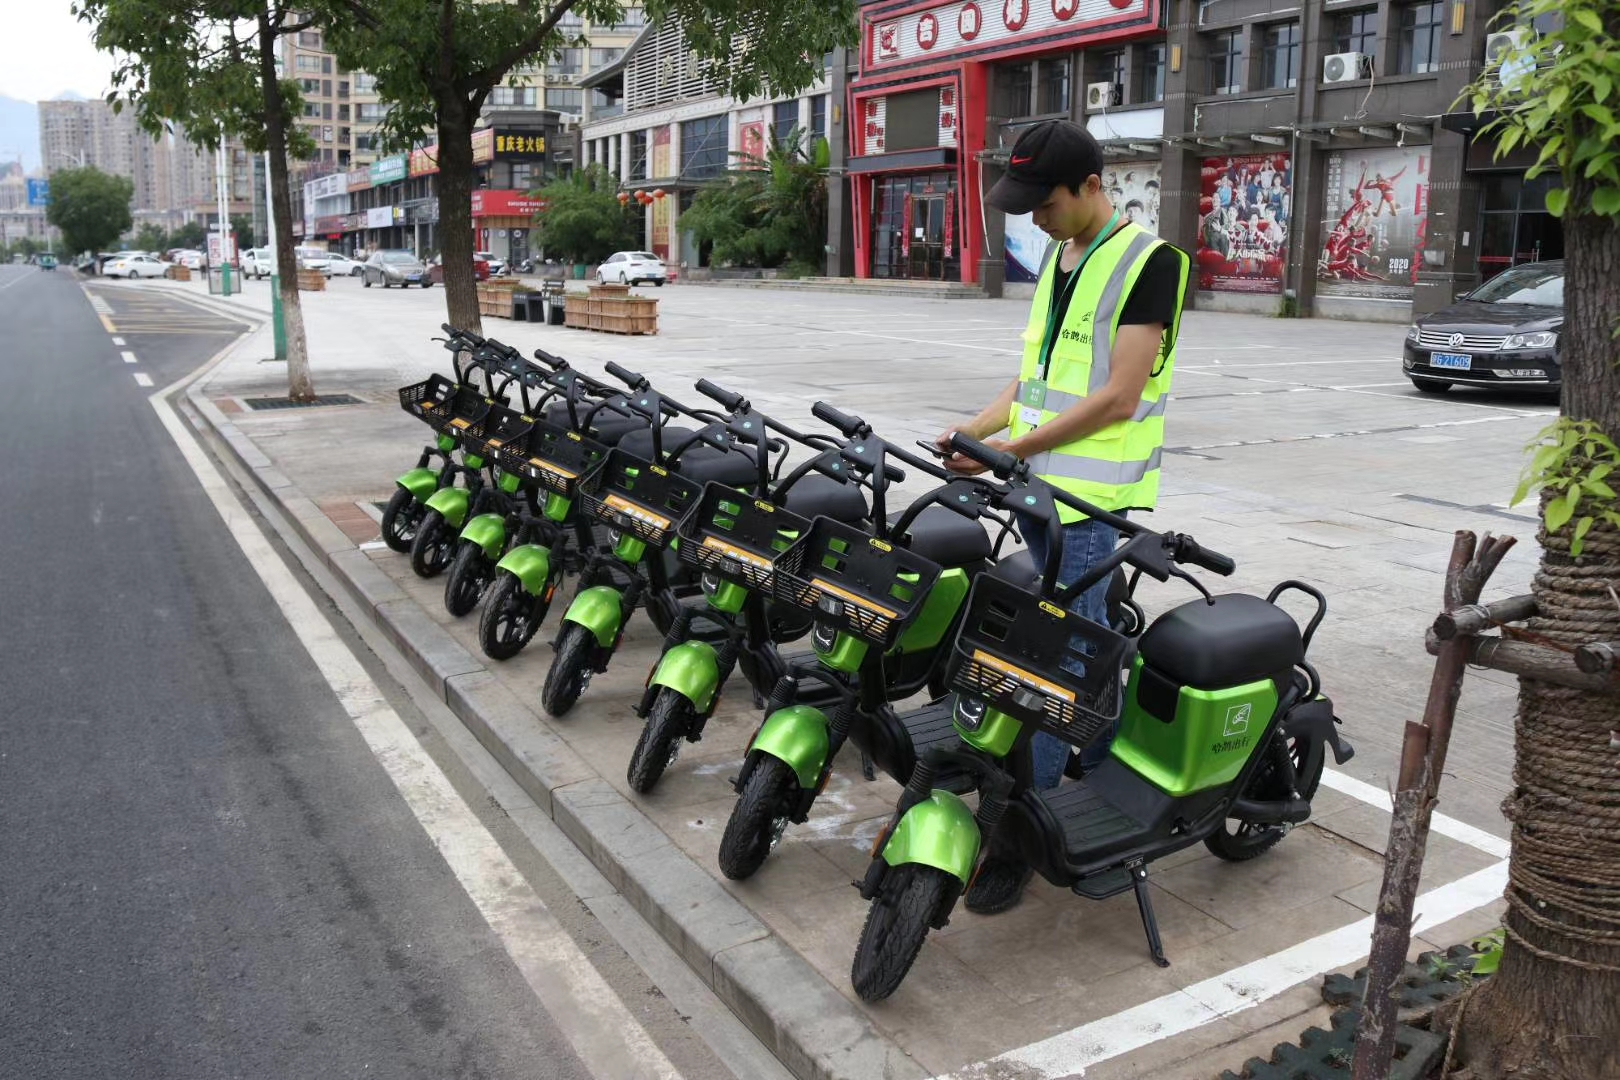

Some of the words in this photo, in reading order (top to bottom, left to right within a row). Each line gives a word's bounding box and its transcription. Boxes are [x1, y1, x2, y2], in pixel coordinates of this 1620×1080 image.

[496, 135, 545, 153] 重庆老火锅
[1389, 258, 1409, 270] 2020
